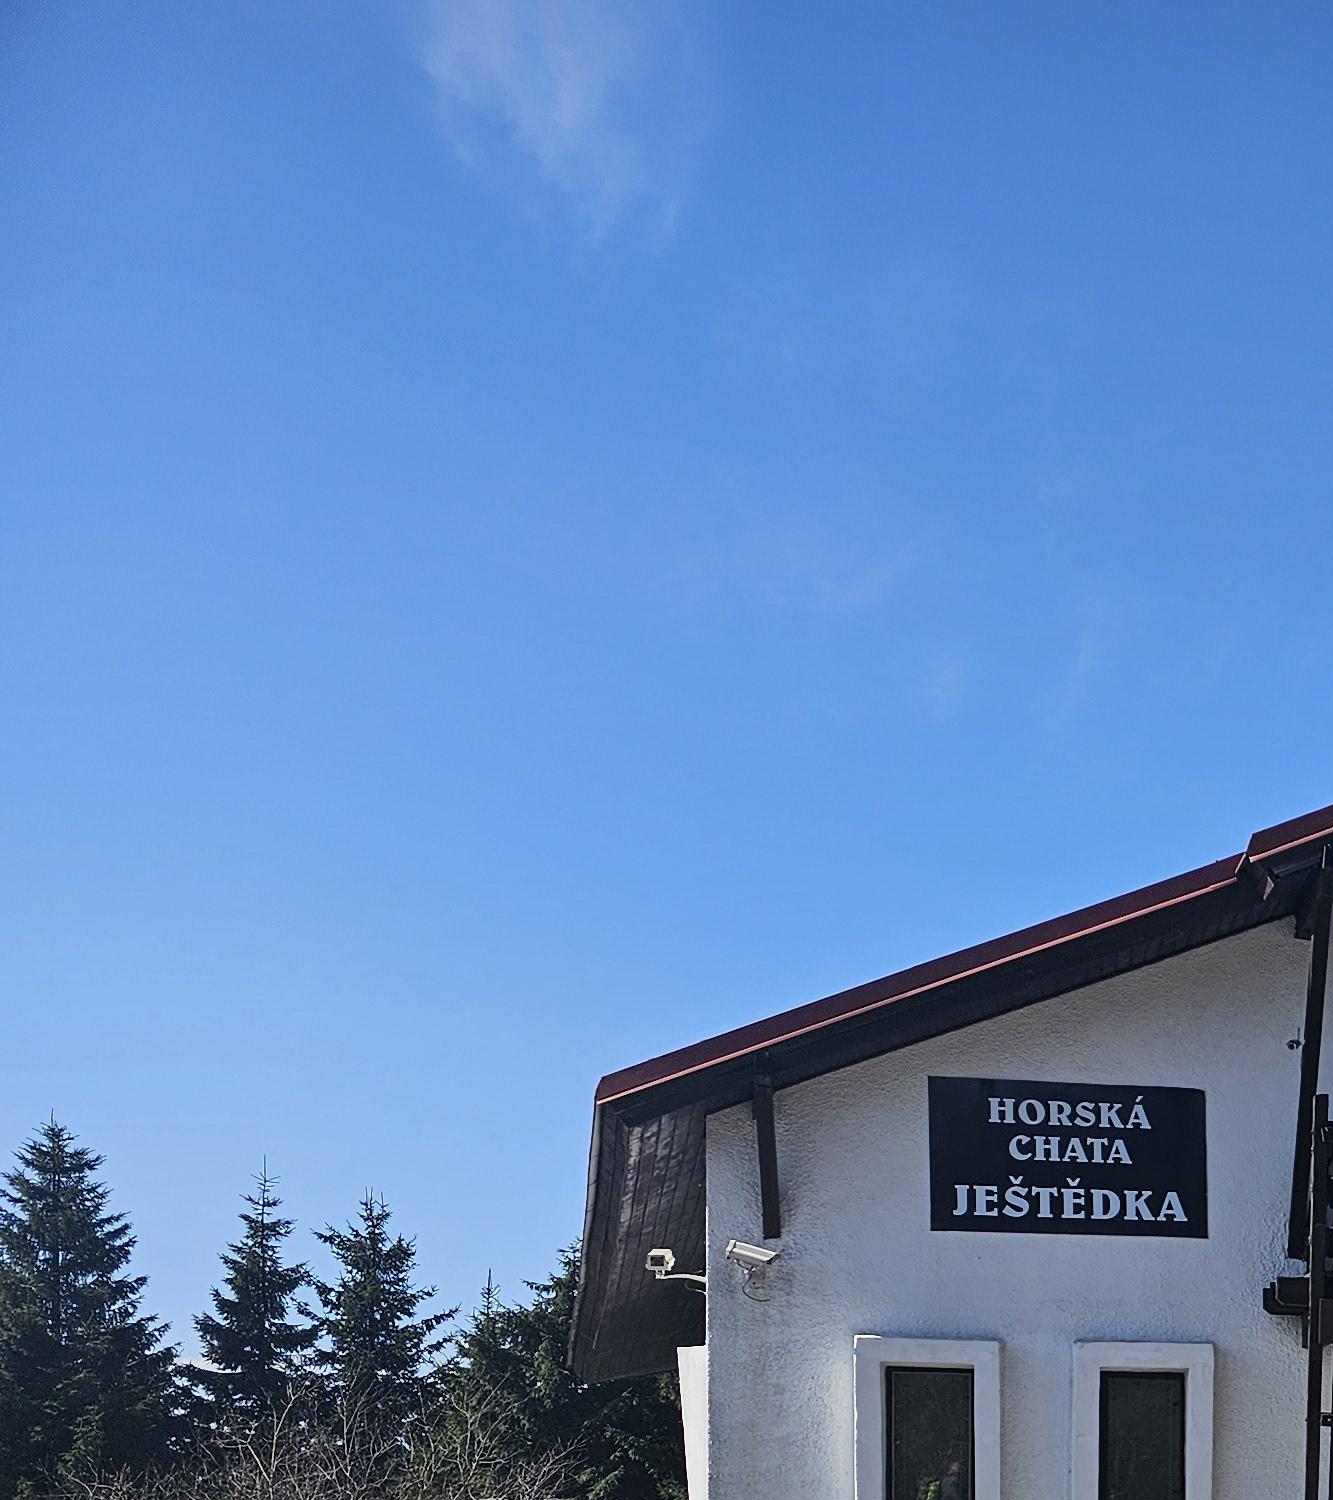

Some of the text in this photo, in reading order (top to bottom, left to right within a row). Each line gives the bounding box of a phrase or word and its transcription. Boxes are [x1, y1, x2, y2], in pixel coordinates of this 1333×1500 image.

[988, 1096, 1151, 1129] HORSKÁ
[1009, 1135, 1132, 1164] CHATA
[953, 1176, 1187, 1221] JEŠTĚDKA
